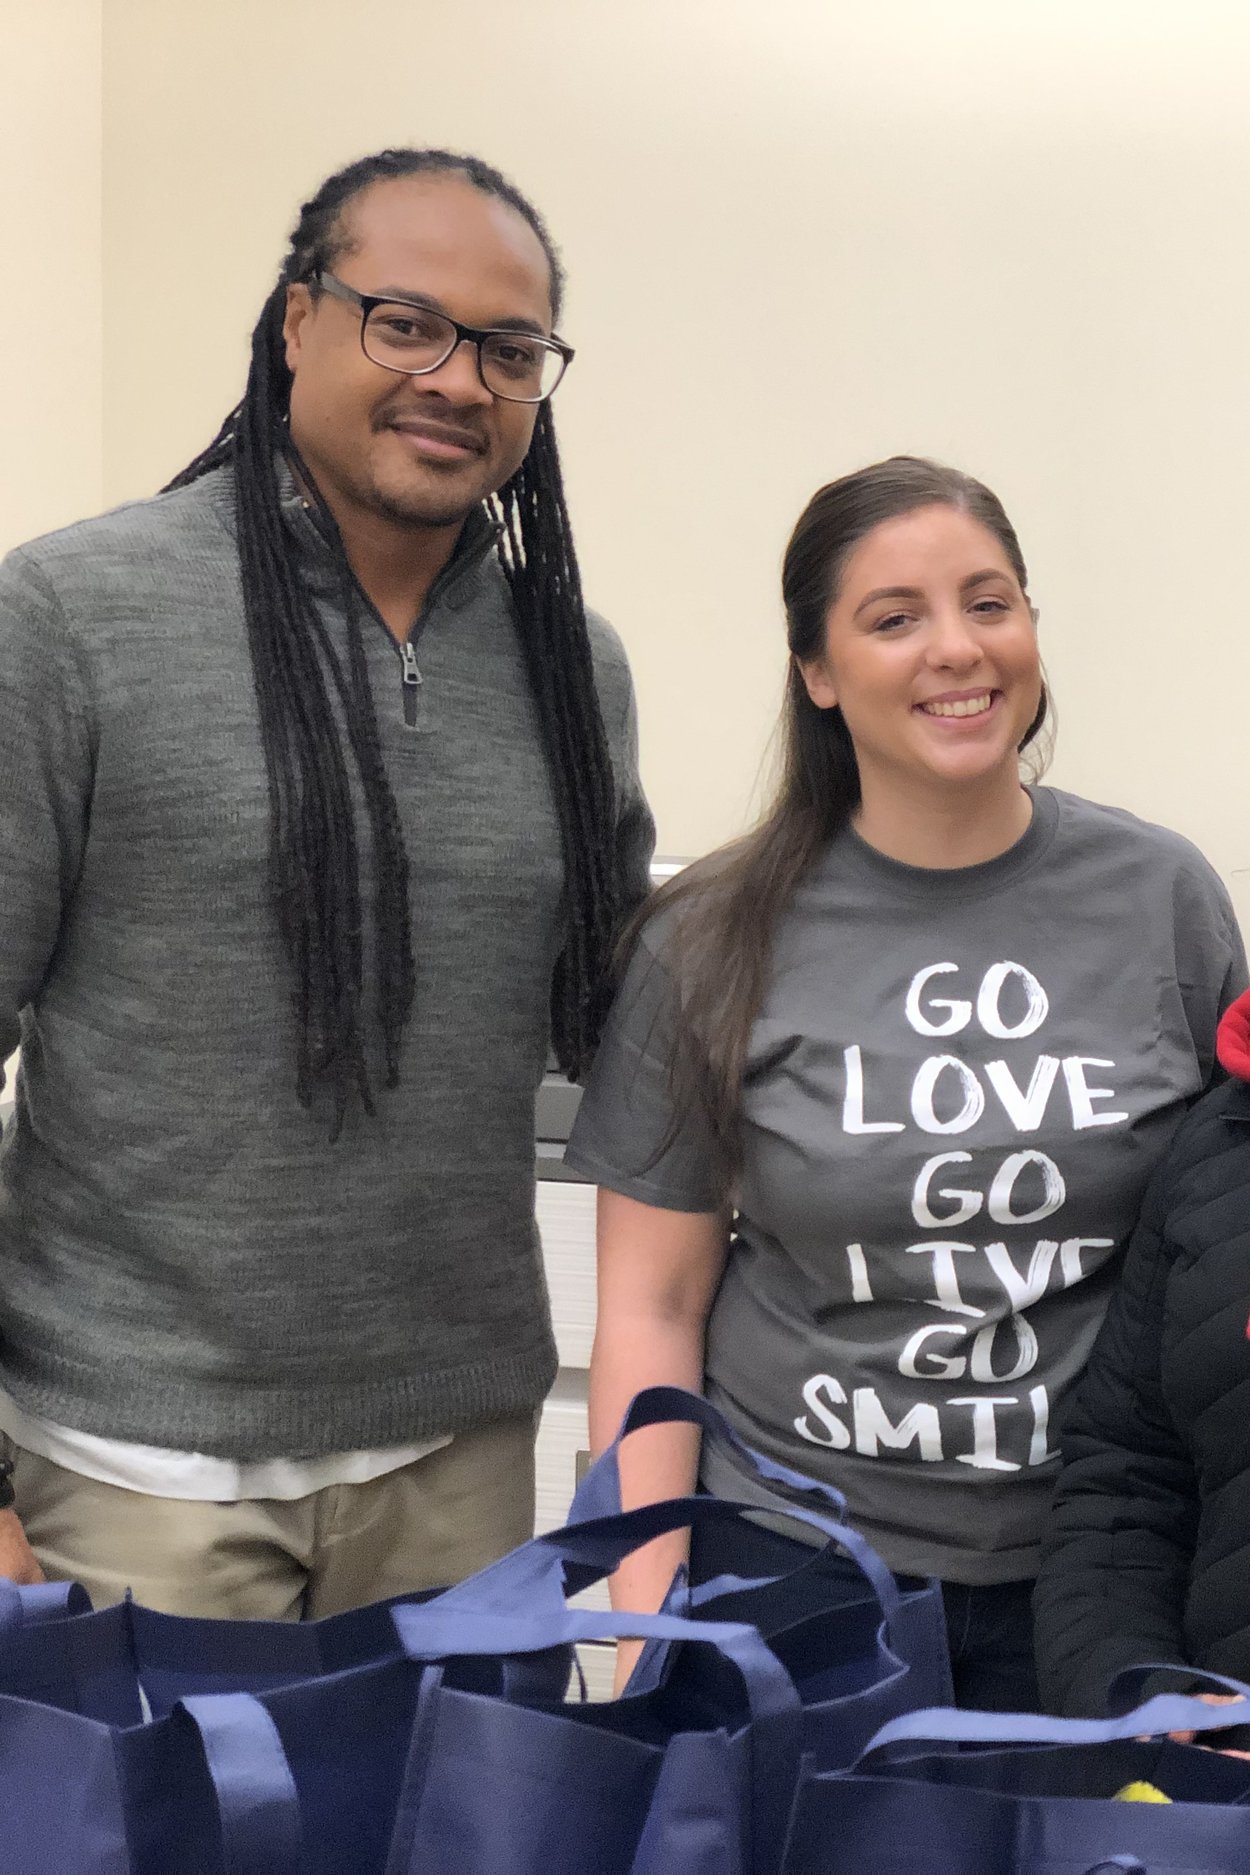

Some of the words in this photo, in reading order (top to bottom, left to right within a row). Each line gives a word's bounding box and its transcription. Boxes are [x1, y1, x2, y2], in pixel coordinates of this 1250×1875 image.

[905, 960, 1049, 1039] GO
[842, 1044, 1129, 1134] LOVE
[911, 1149, 1066, 1228] GO
[898, 1312, 1039, 1383] GO
[793, 1374, 1063, 1471] SMIL
